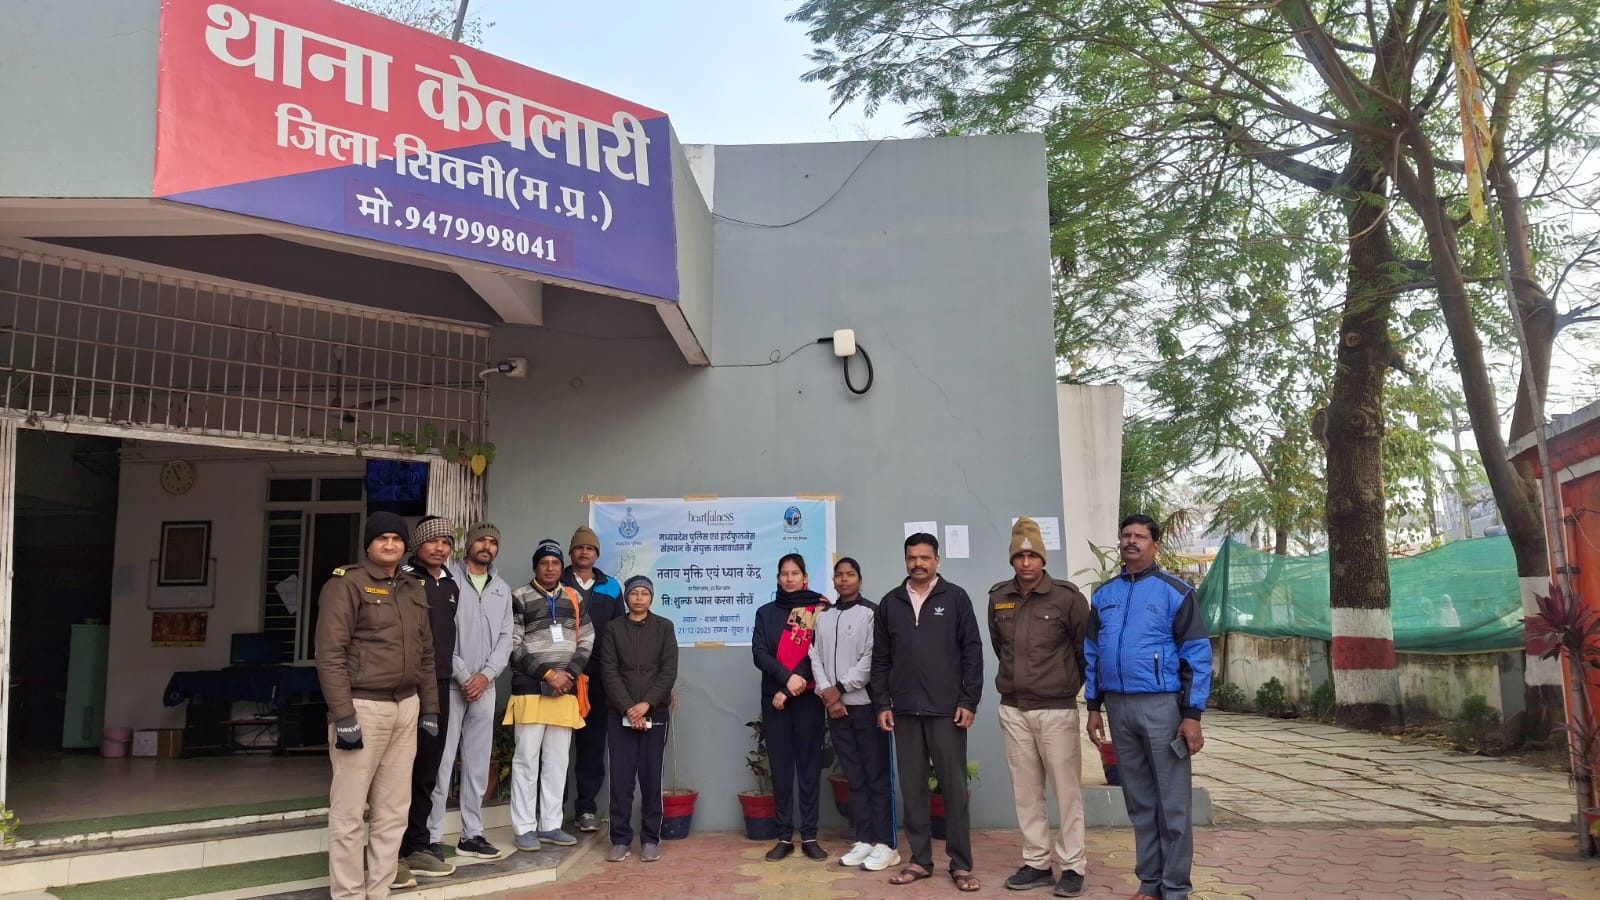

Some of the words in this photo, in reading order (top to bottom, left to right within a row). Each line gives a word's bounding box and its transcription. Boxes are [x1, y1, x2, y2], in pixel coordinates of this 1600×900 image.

[205, 3, 393, 112] थाना
[415, 54, 651, 186] केवलारी
[356, 187, 556, 262] मो.9479998041
[688, 510, 734, 526] heartfulness
[658, 531, 688, 541] मध्यप्रदेश
[689, 530, 708, 543] पुलिस
[709, 531, 719, 541] एवं
[720, 530, 756, 542] हार्टफुलनेस
[660, 543, 684, 553] संस्थान
[685, 543, 692, 552] के
[693, 543, 712, 554] संयुक्त
[656, 568, 681, 579] तनाव
[682, 564, 704, 582] मुक्ति
[706, 565, 720, 580] एवं
[722, 567, 744, 579] ध्यान
[746, 564, 762, 580] केंद्र
[694, 595, 712, 606] ध्यान
[714, 595, 734, 606] करना
[736, 592, 755, 605] सीखें
